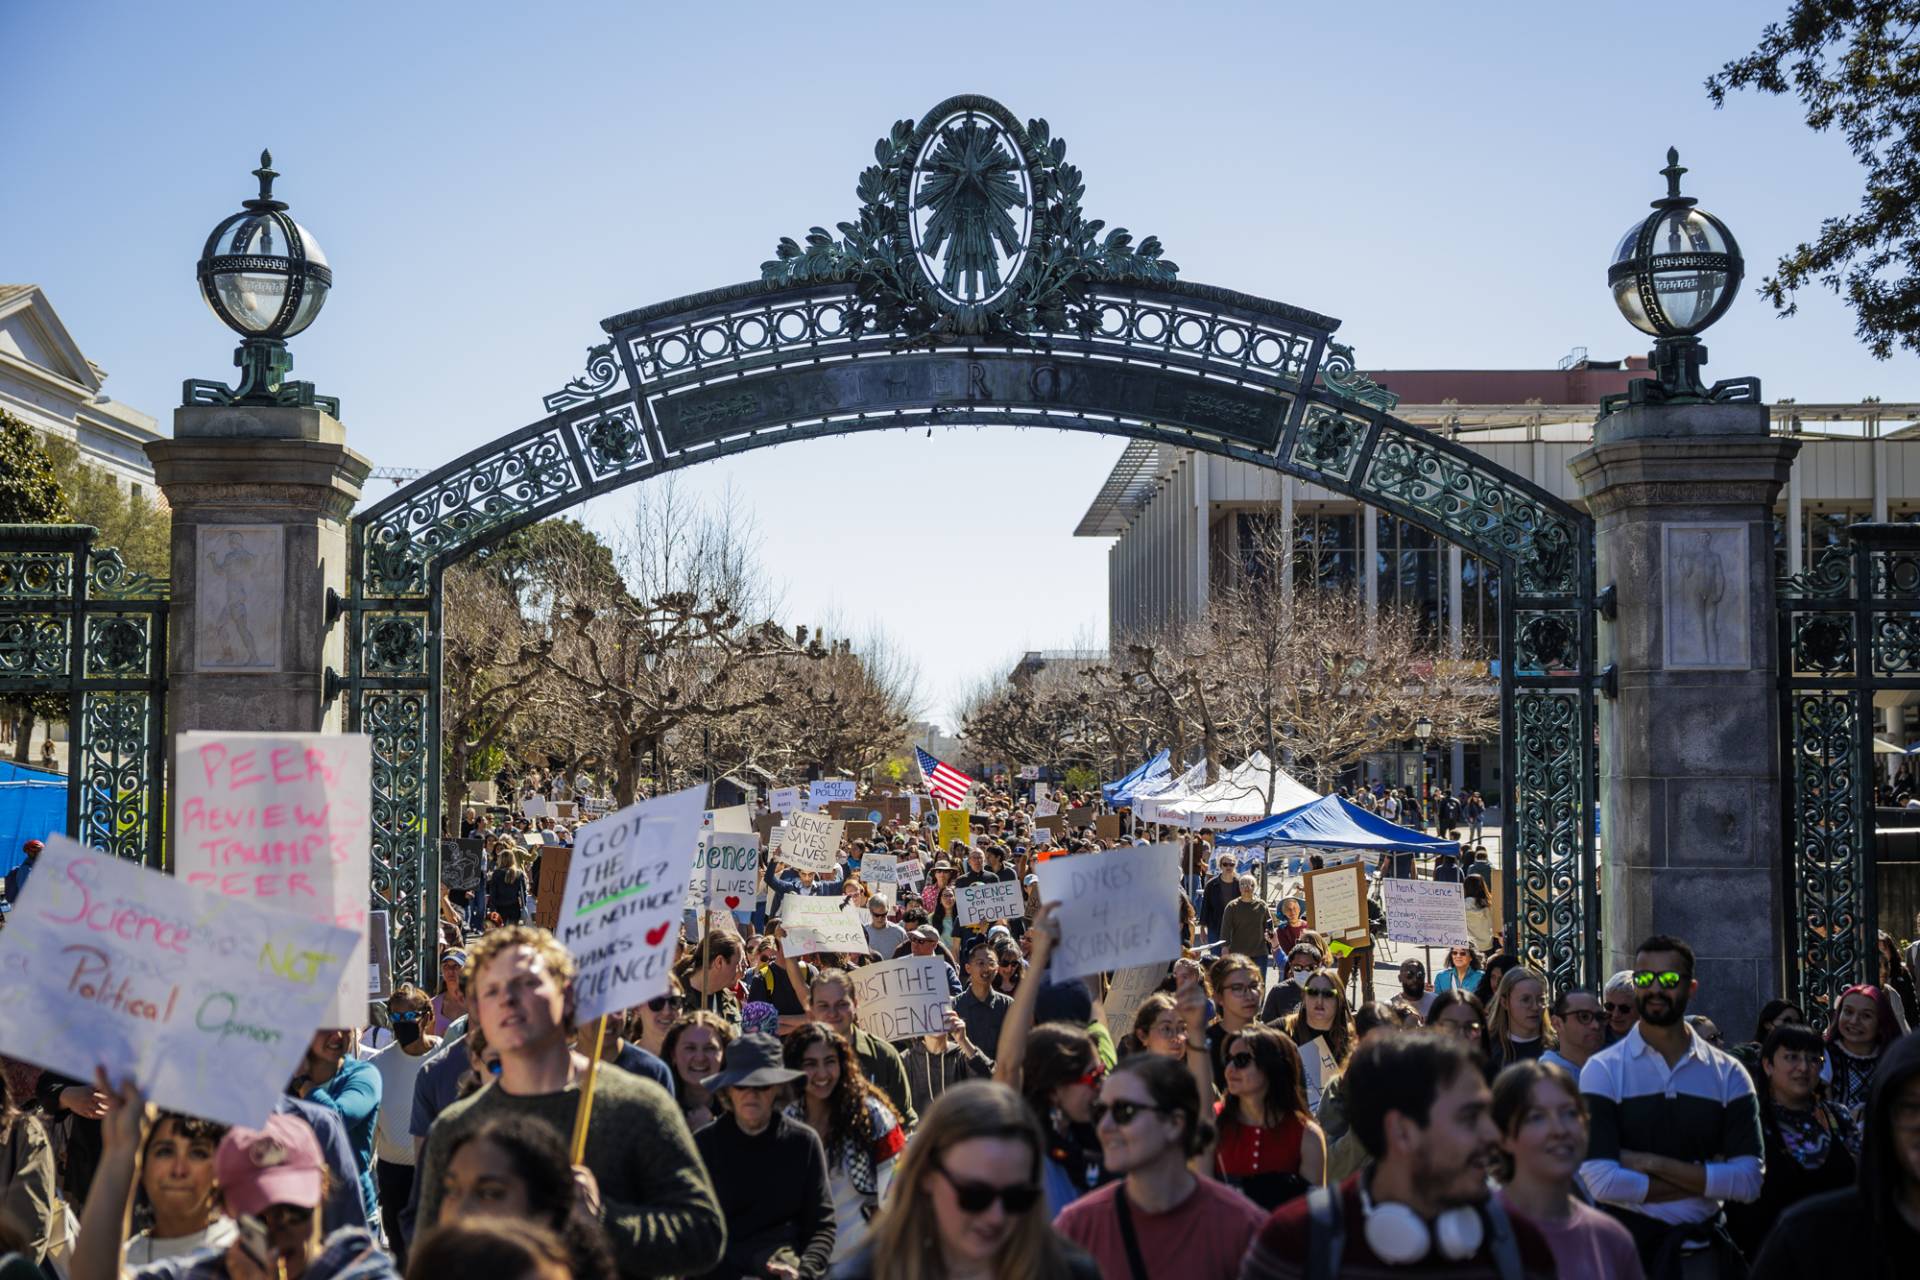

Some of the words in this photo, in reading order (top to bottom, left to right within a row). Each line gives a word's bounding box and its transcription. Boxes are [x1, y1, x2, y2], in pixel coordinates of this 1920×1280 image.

[199, 742, 337, 790] PEER
[182, 797, 330, 835] REVIEW
[789, 811, 835, 835] SCIENCE
[1224, 815, 1250, 823] ASIAN
[582, 813, 648, 858] GOT
[787, 828, 827, 850] SAVES
[691, 842, 757, 872] ience
[792, 844, 829, 861] LIVES
[577, 861, 669, 909] PLAGUE?
[582, 852, 624, 888] THE
[1071, 861, 1133, 899] DYKES
[716, 879, 756, 896] LIVES
[964, 884, 1014, 902] SCIENCE
[1417, 882, 1453, 897] Science
[41, 858, 193, 954] Science
[258, 942, 337, 983] NOT
[967, 904, 1019, 922] PEOPLE
[1091, 901, 1109, 926] 4
[564, 918, 594, 945] ME
[1064, 911, 1155, 966] SCIENCE!
[60, 943, 180, 1023] Political
[854, 971, 890, 1001] RUST
[891, 965, 936, 992] THE
